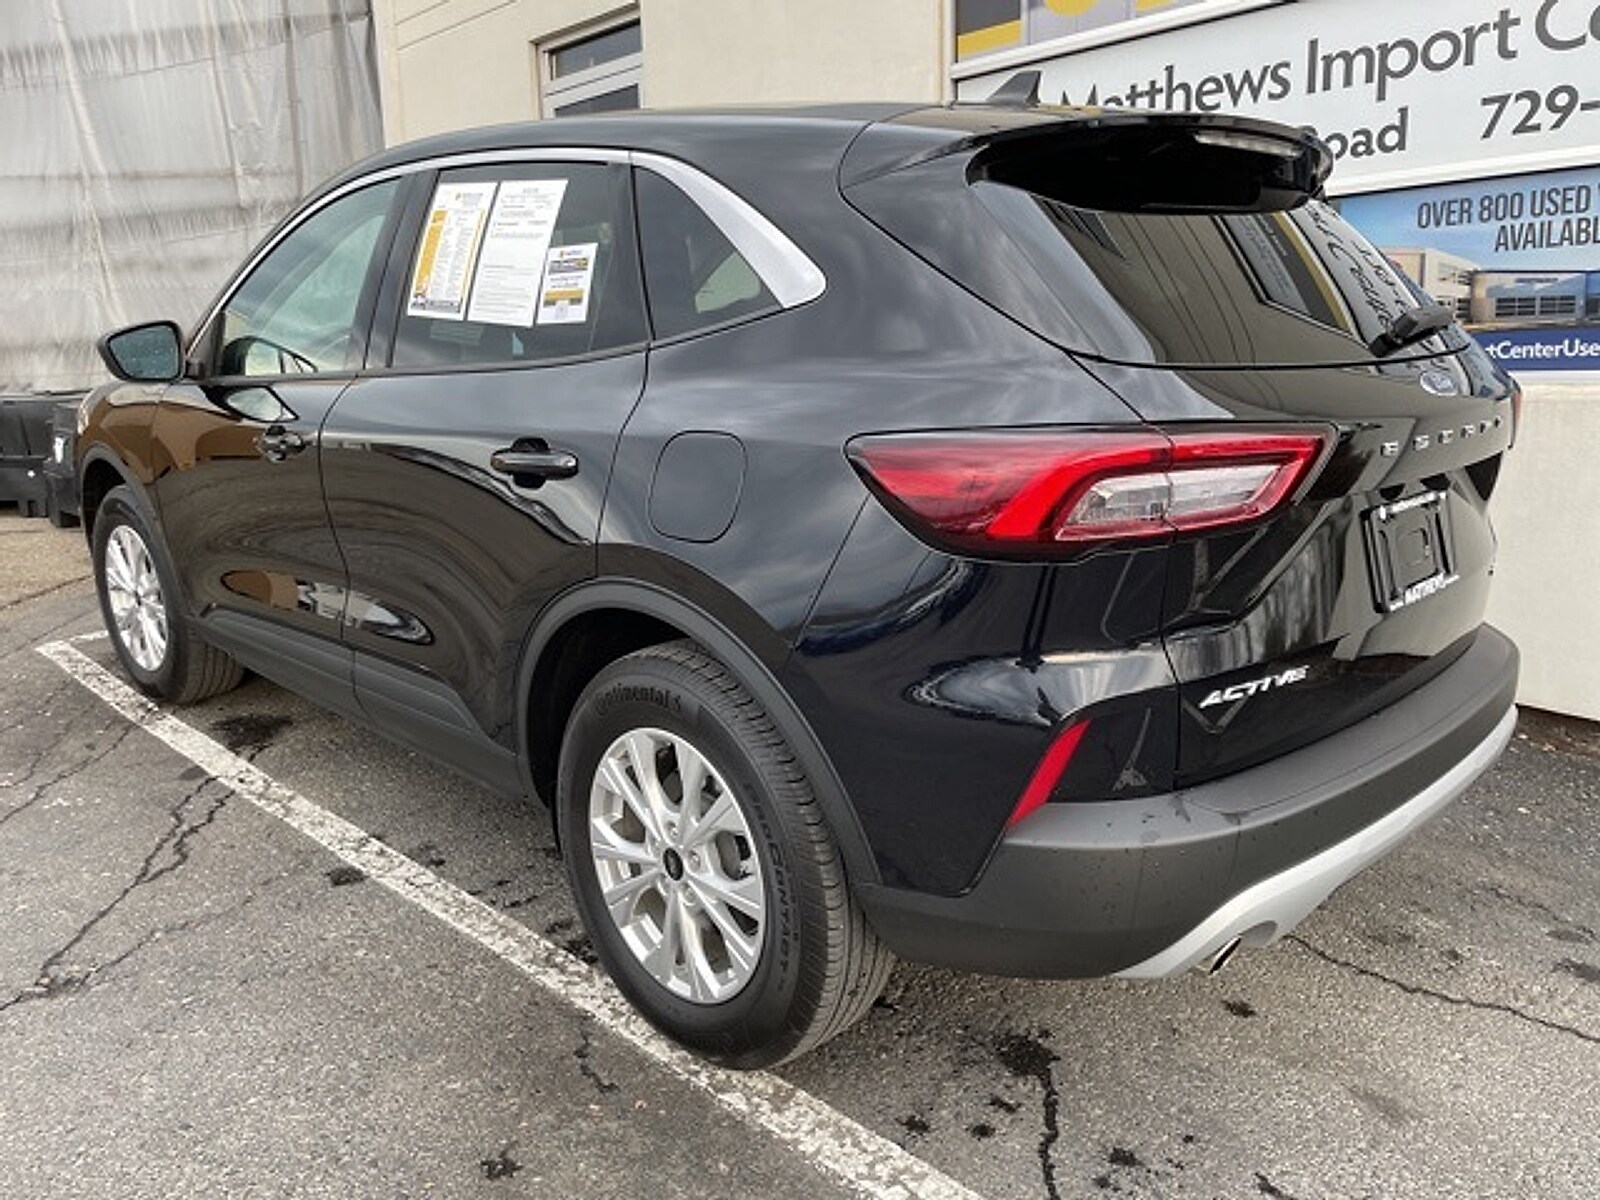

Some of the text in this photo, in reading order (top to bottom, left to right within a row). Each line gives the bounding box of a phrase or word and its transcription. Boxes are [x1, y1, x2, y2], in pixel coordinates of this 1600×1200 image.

[1305, 8, 1521, 103] Import
[1535, 0, 1600, 51] C
[1302, 105, 1409, 161] oad
[1417, 184, 1591, 229] OVER 800 USED
[1199, 664, 1310, 709] ACTIVE
